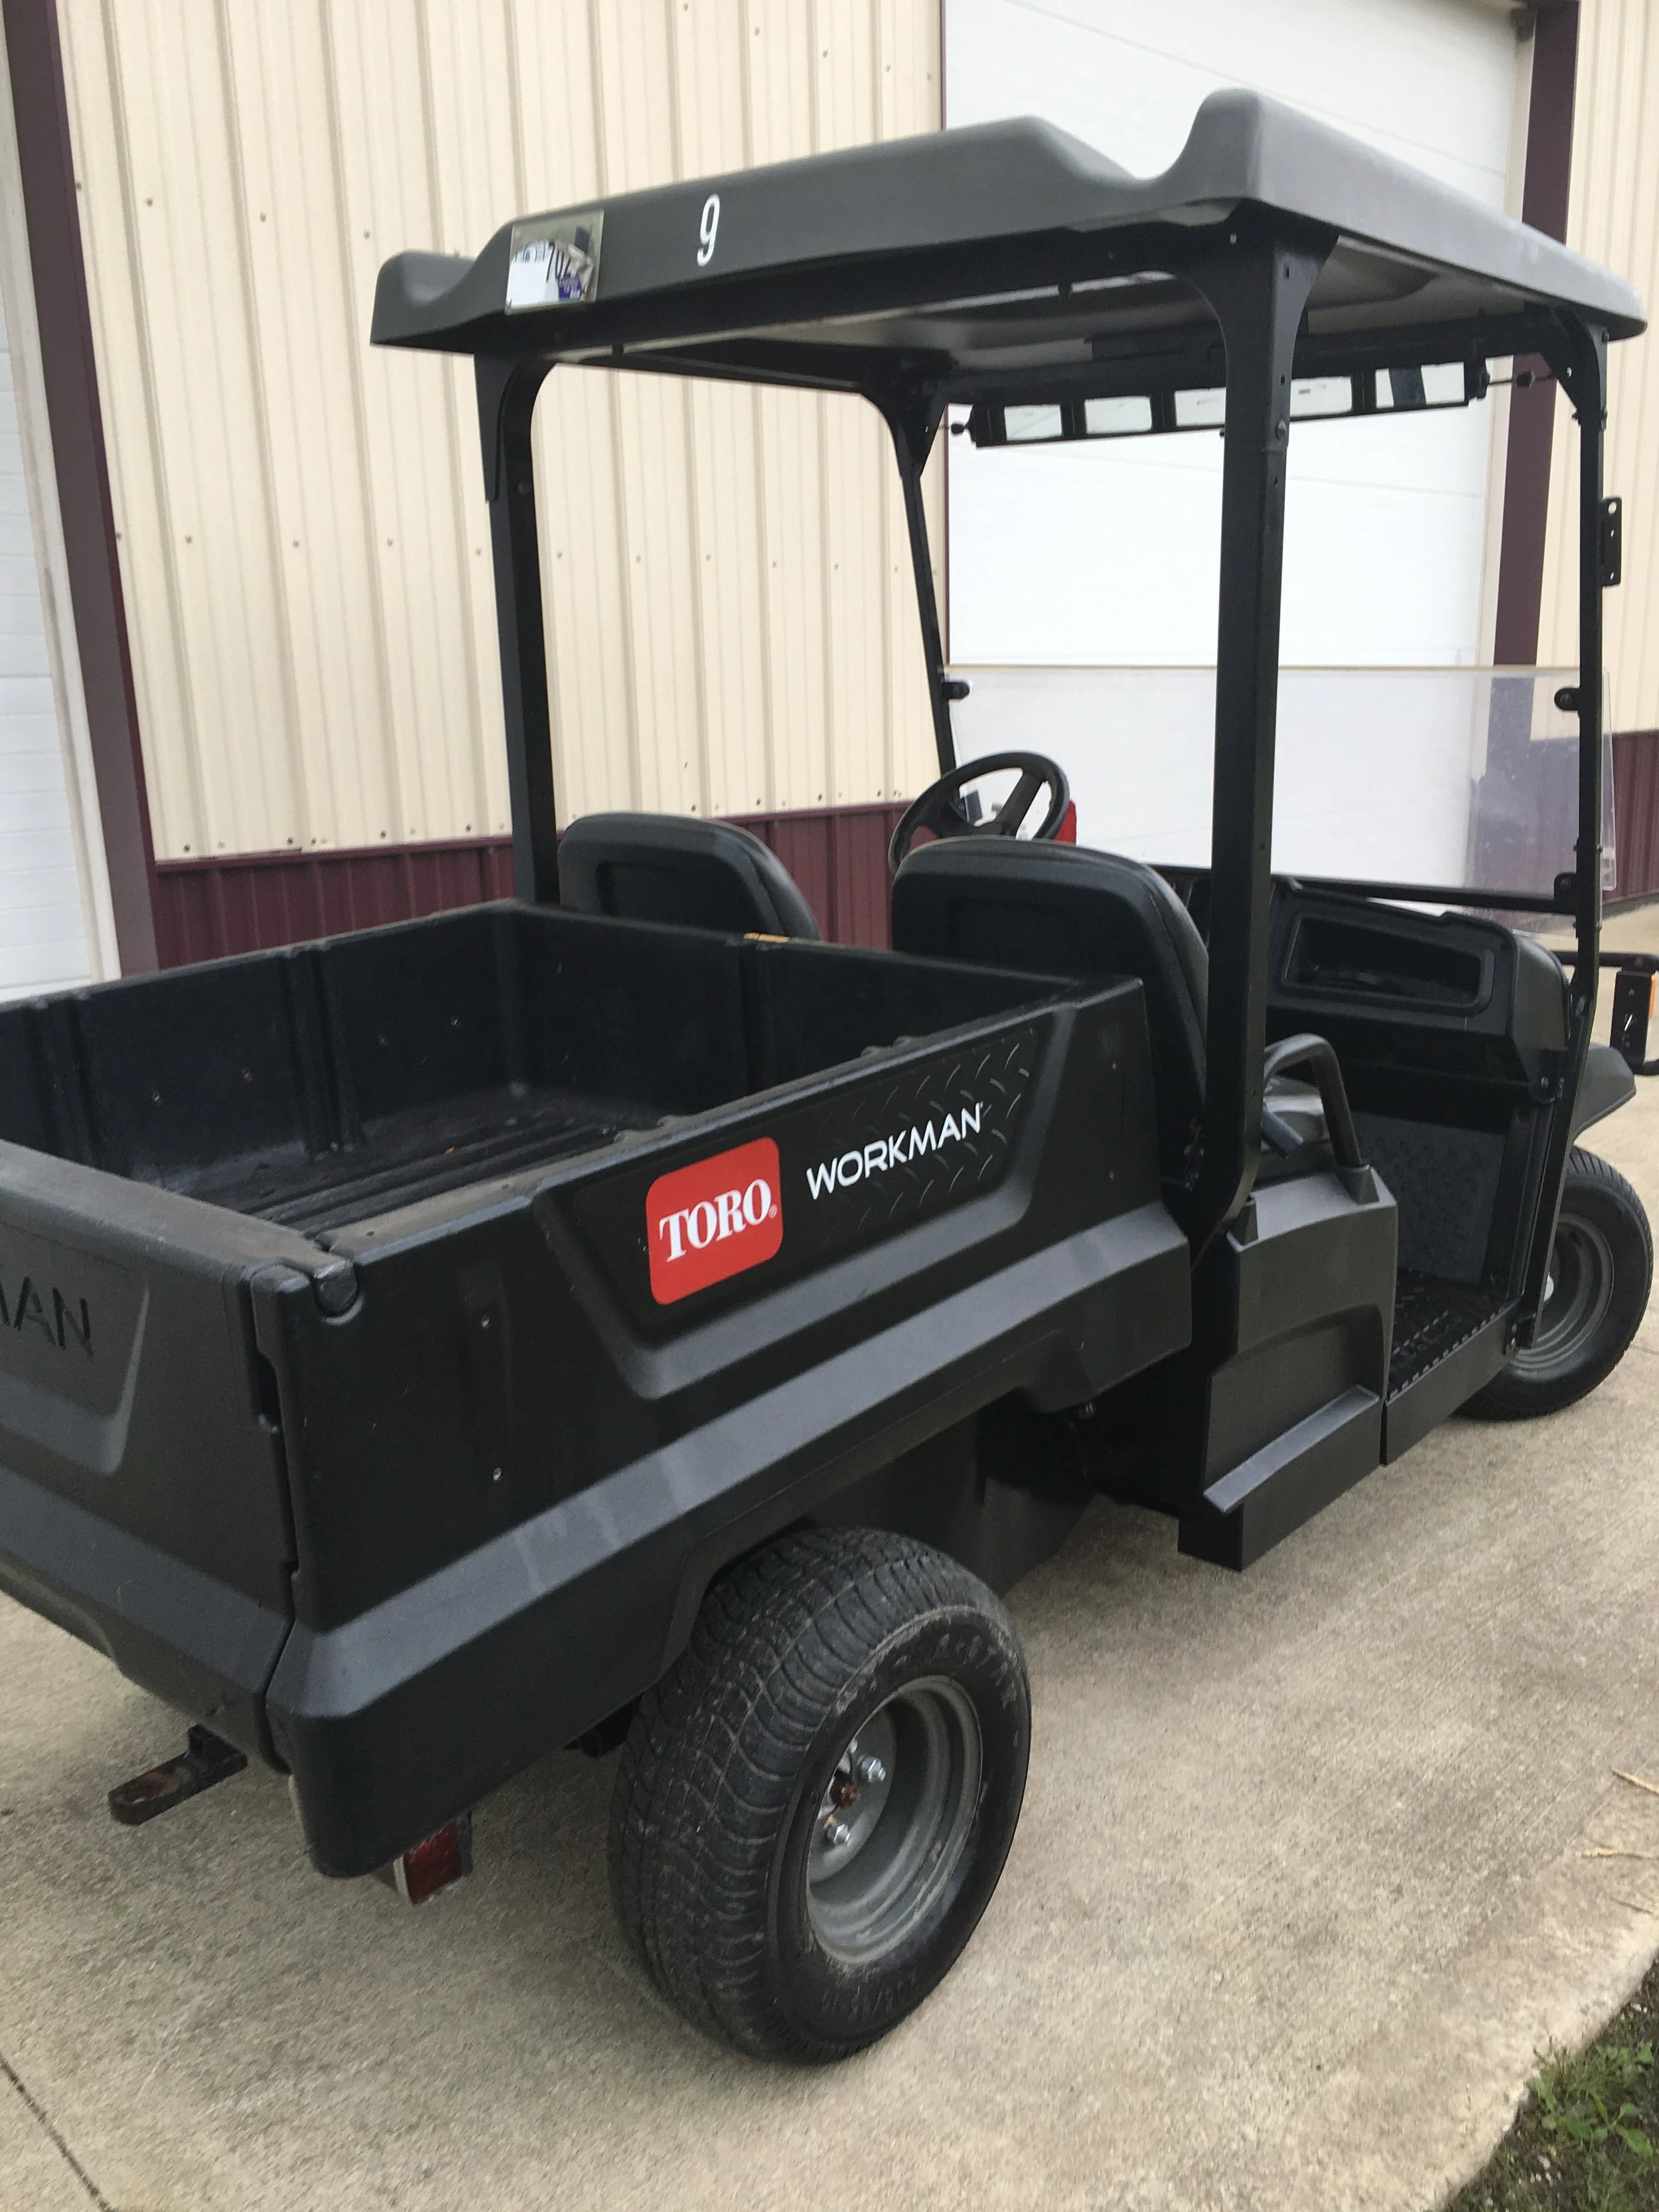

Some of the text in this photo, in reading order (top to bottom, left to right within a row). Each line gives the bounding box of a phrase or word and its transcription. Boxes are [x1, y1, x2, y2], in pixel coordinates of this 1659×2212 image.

[697, 193, 721, 267] 9
[806, 1101, 981, 1200] WORKMAN
[660, 1178, 772, 1262] TORO
[0, 1276, 94, 1357] AN
